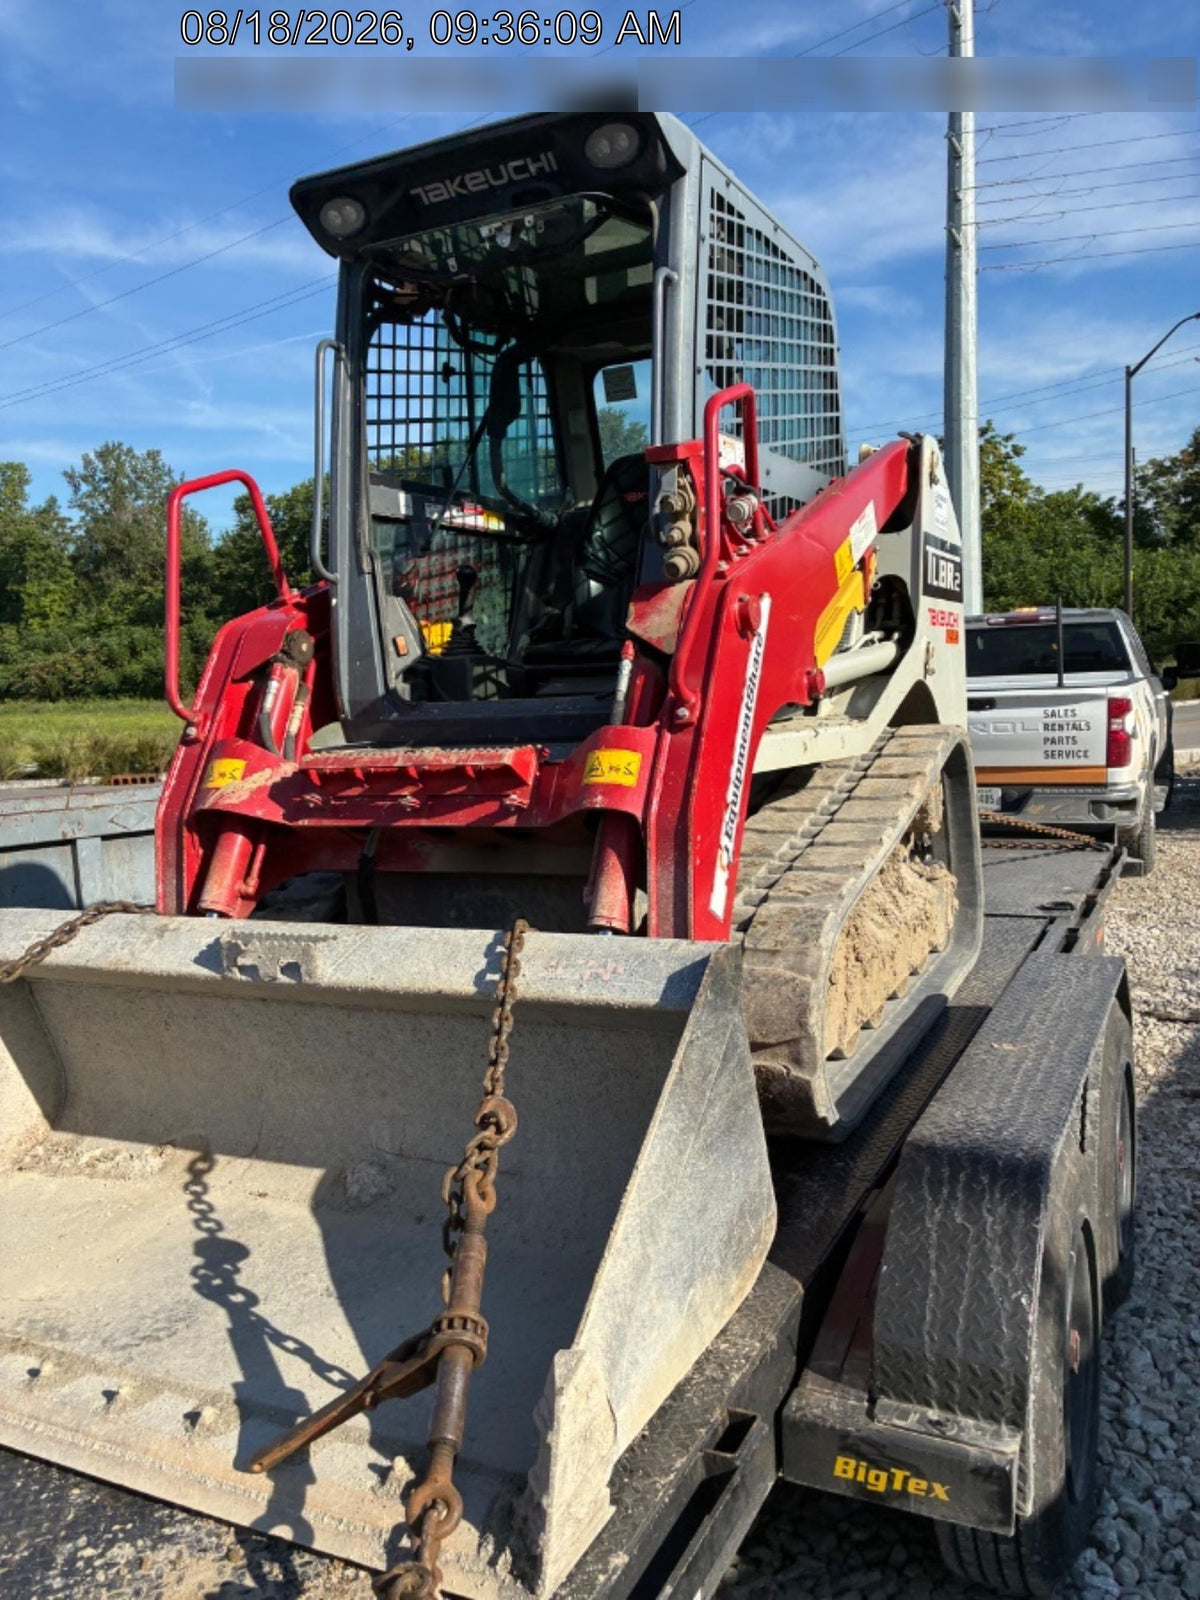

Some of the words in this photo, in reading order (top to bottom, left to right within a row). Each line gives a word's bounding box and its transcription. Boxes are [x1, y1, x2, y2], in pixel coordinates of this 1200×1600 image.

[409, 151, 559, 206] TAKEUCHI
[1043, 709, 1077, 719] SALES
[1043, 722, 1091, 732] RENTALS
[724, 632, 764, 841] EquipmentShare
[1043, 736, 1078, 746] PARTS
[1043, 750, 1090, 760] SERVICE
[833, 1455, 950, 1501] BigTex
